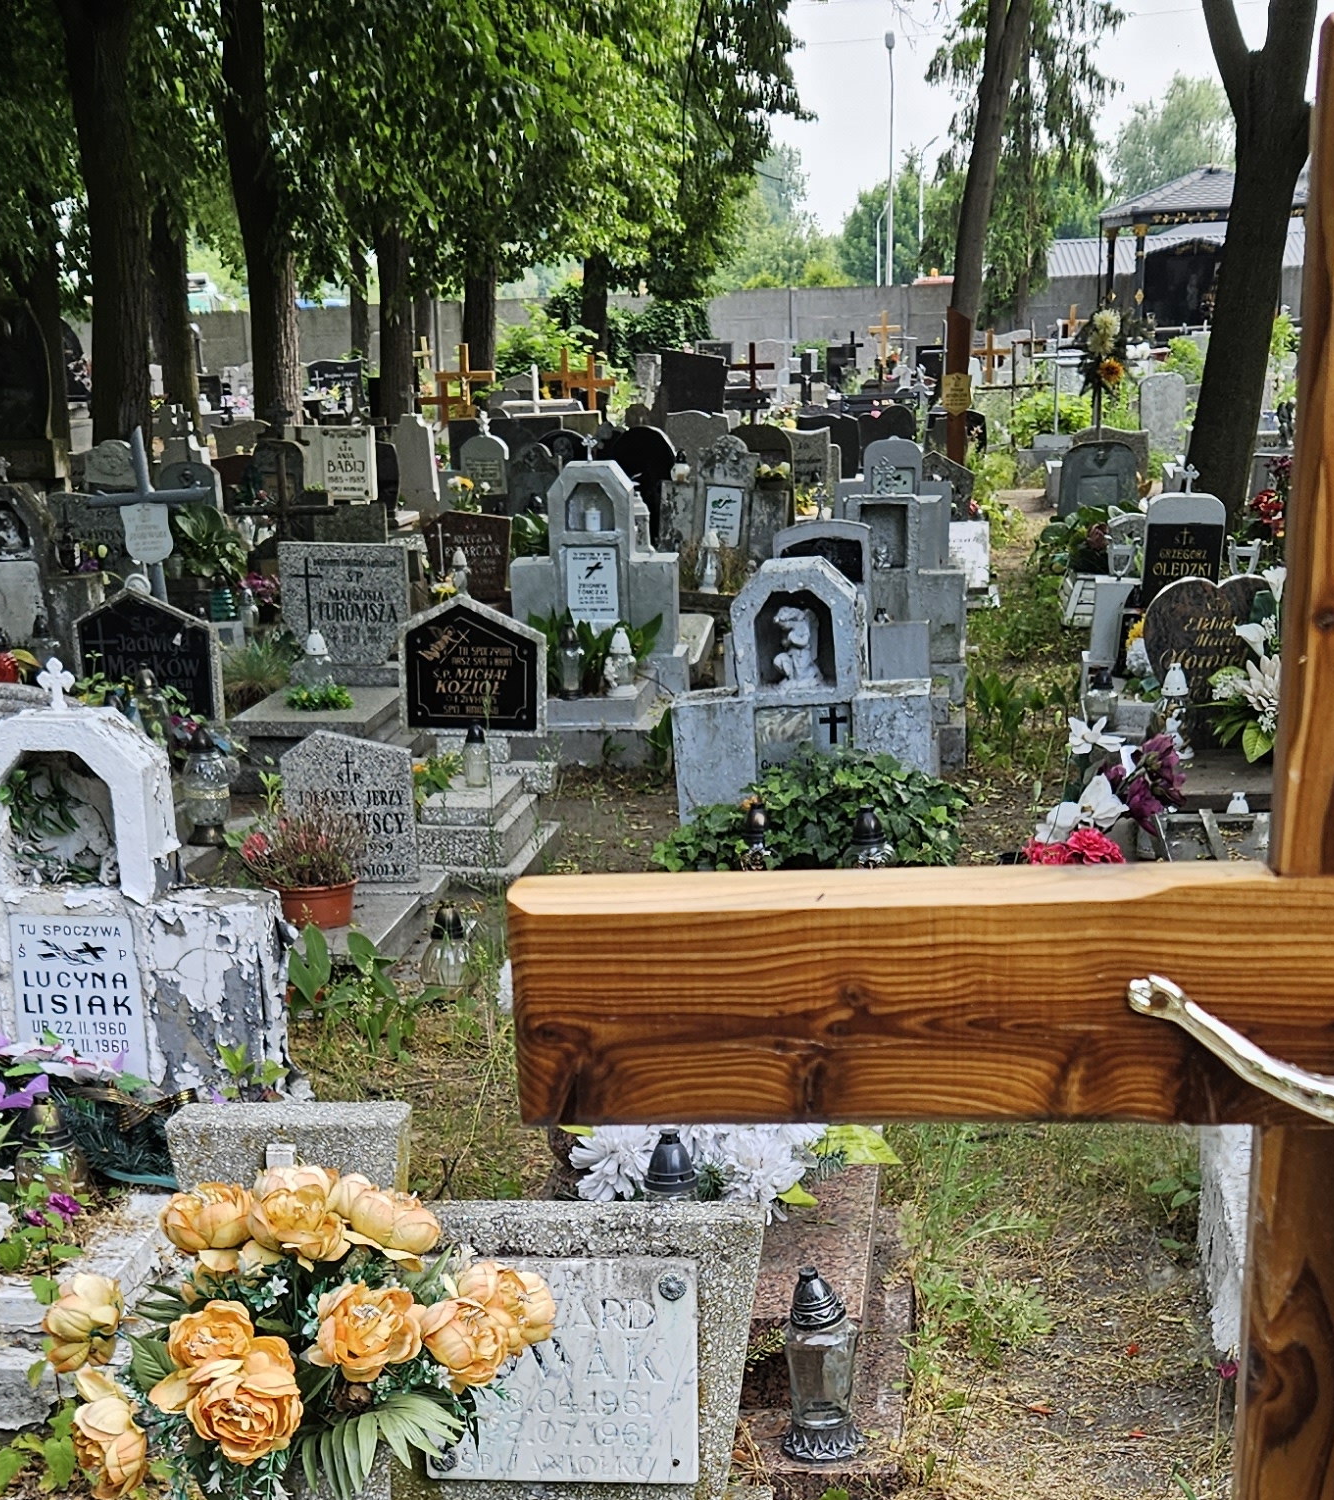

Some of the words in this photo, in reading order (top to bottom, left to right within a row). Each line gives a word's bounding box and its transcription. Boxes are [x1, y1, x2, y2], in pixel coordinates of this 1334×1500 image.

[1159, 549, 1208, 560] GRZEGORZ
[456, 668, 507, 680] MICHAŁ
[19, 924, 35, 935] TU
[43, 925, 121, 937] SPOCZYWA
[119, 949, 126, 960] P
[23, 970, 128, 989] LUCYNA
[23, 994, 132, 1016] LISIAK
